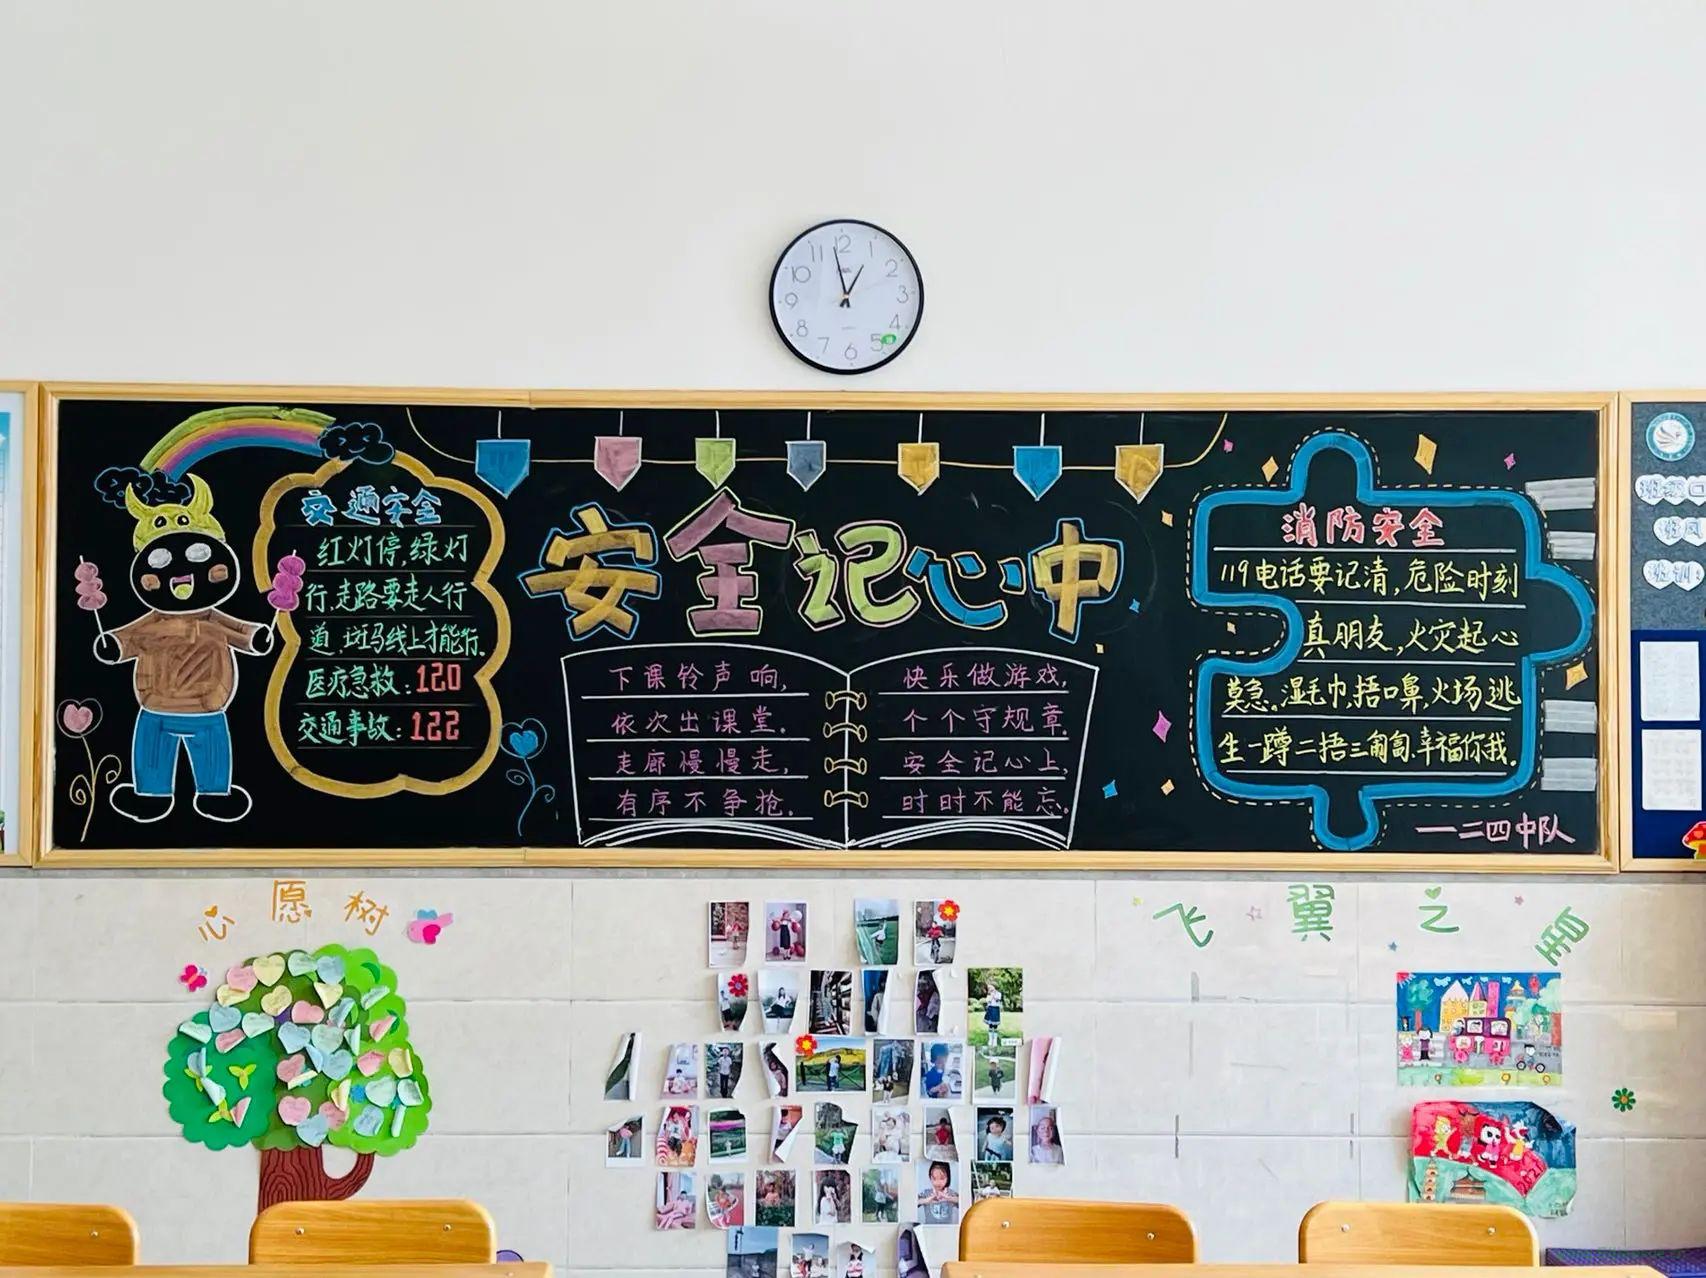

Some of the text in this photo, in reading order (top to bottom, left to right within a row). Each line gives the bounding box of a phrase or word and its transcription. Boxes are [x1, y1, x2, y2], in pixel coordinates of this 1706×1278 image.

[808, 240, 824, 262] 11
[835, 235, 852, 253] 12
[791, 266, 812, 284] 10
[885, 258, 899, 278] 2
[784, 292, 798, 308] 9
[896, 285, 909, 304] 3
[796, 319, 809, 338] 8
[889, 314, 900, 330] 4
[818, 337, 830, 354] 7
[844, 342, 858, 360] 6
[870, 333, 885, 352] 5
[300, 484, 443, 529] 交通安全
[1280, 502, 1446, 548] 消防安全
[518, 486, 1126, 643] 安全记心中
[1414, 811, 1576, 850] 一二四中队
[198, 880, 389, 942] 心愿树
